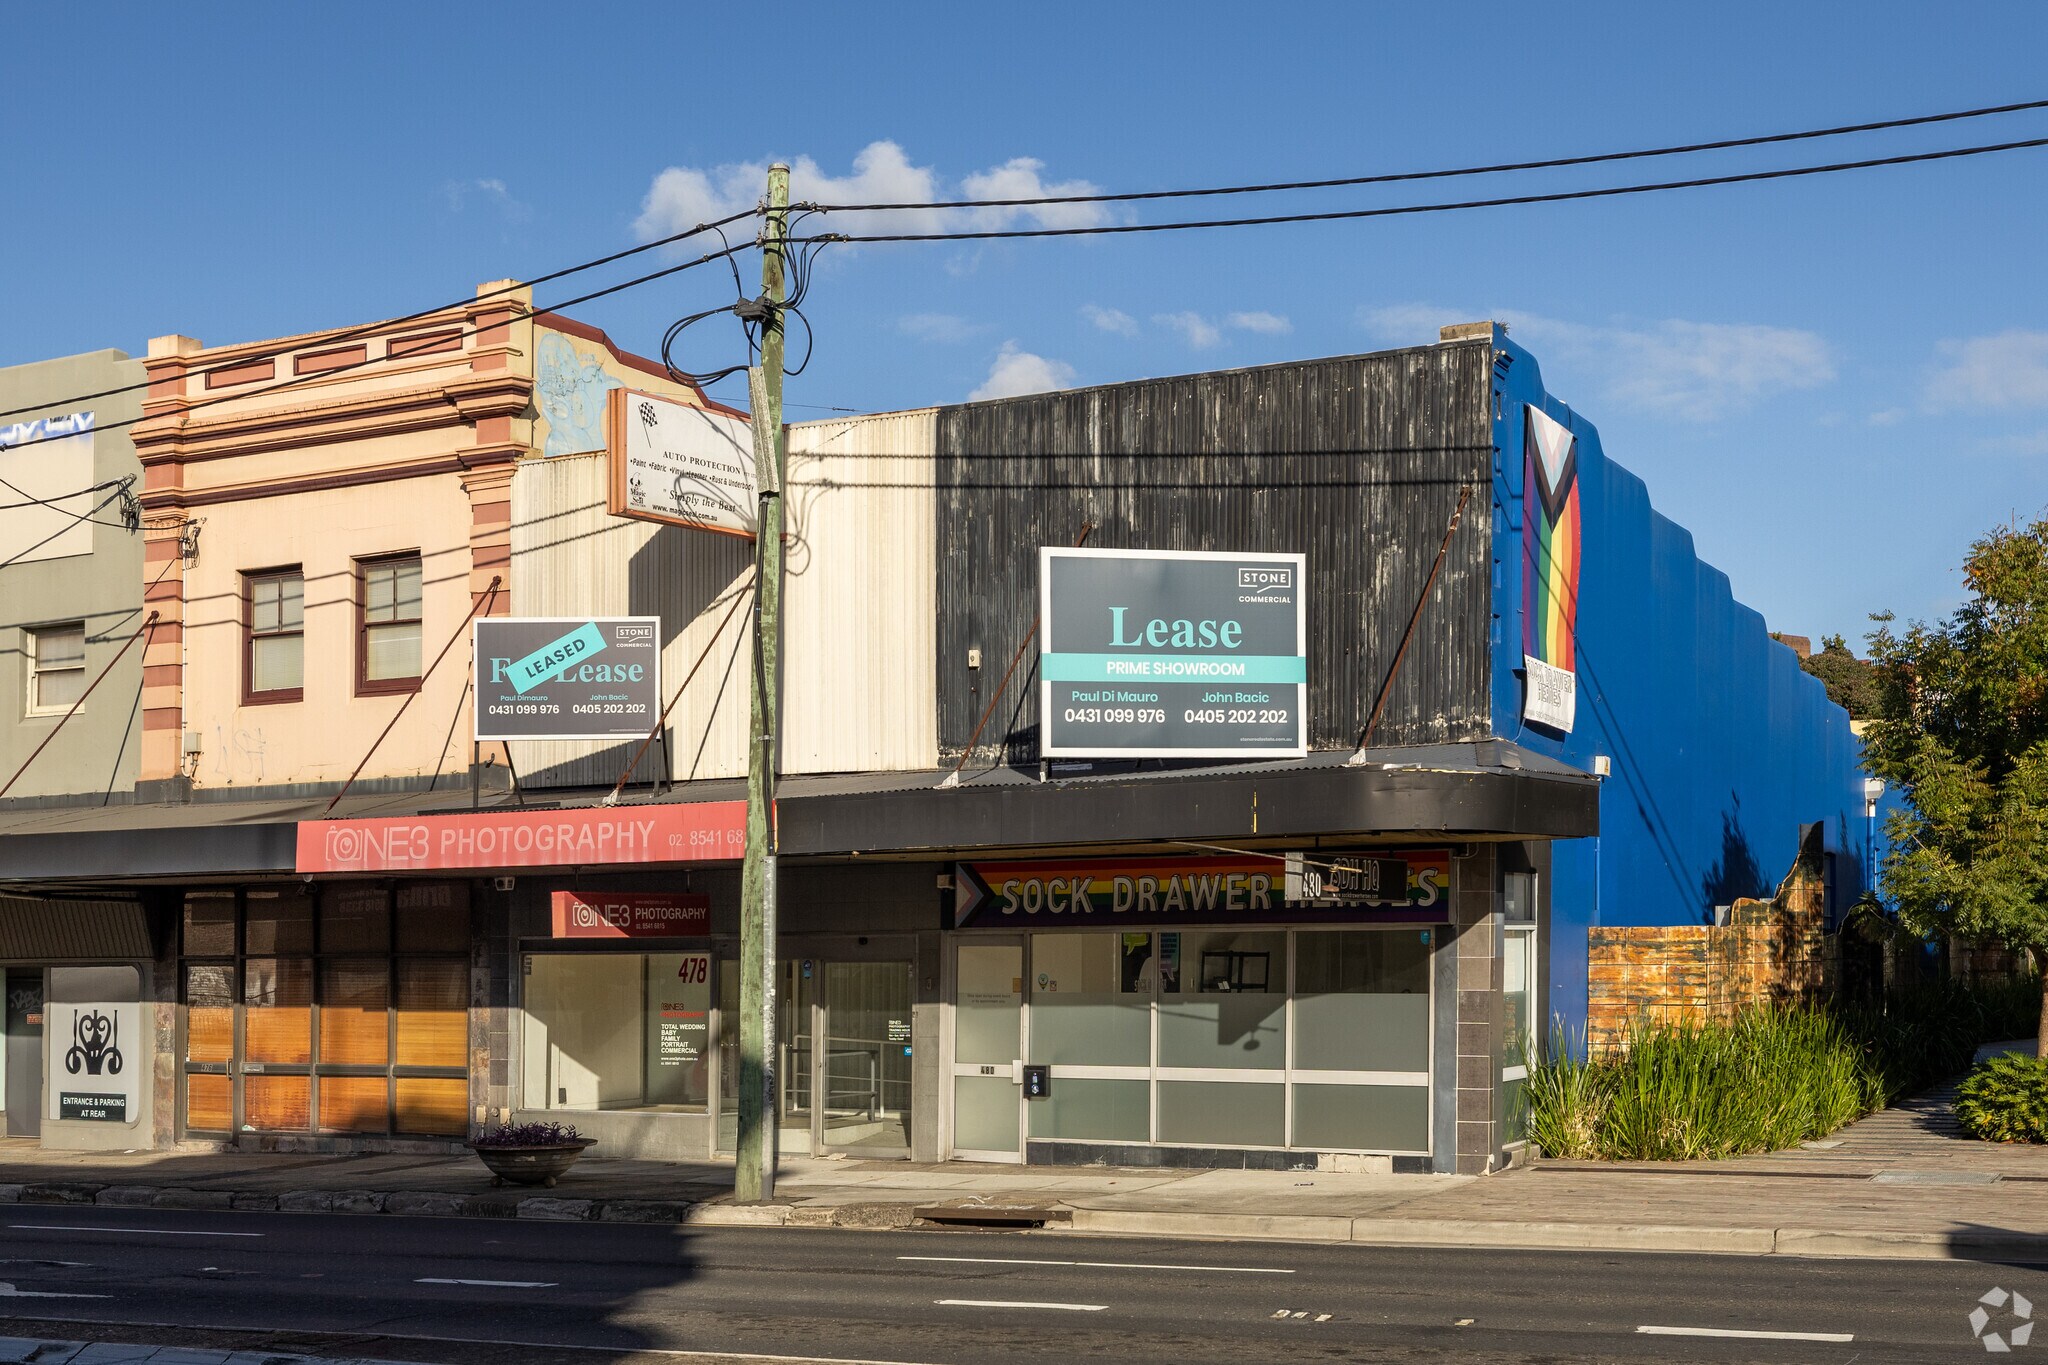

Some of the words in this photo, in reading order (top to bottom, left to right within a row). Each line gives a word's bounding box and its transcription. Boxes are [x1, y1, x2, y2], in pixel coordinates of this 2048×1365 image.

[662, 450, 687, 462] AUTO
[689, 455, 741, 475] PROTECTION
[712, 474, 723, 485] Rust
[728, 479, 755, 492] Underbody
[669, 489, 699, 507] Simply
[702, 496, 716, 508] the
[719, 500, 736, 513] Best
[1243, 572, 1287, 584] STONE
[1238, 595, 1291, 604] COMMERCIAL
[619, 628, 650, 637] STONE
[1108, 606, 1243, 649] Lease
[524, 638, 586, 679] LEASED
[1106, 661, 1151, 675] PRIME
[1153, 662, 1246, 676] SHOWROOM
[500, 694, 517, 702] Paul
[518, 694, 549, 702] Dimauro
[589, 693, 608, 702] John
[609, 693, 629, 701] Bacic
[1072, 690, 1100, 702] Paul
[1102, 690, 1115, 702] Di
[1117, 691, 1159, 702] Mauro
[1202, 692, 1233, 703] John
[1235, 692, 1270, 703] Bacic
[489, 704, 514, 715] 0431
[516, 704, 538, 715] 099
[539, 704, 560, 715] 976
[572, 704, 601, 715] 0405
[603, 704, 624, 714] 202
[625, 703, 647, 714] 202
[1064, 708, 1101, 723] 0431
[1104, 709, 1135, 723] 099
[1137, 709, 1166, 723] 976
[1184, 709, 1226, 724] 0405
[1228, 710, 1257, 724] 202
[1259, 710, 1288, 724] 202
[440, 820, 655, 855] PHOTOGRAPHY
[668, 834, 685, 847] 02.
[689, 829, 722, 846] 8541
[1362, 859, 1380, 892] HQ
[1302, 871, 1321, 898] 480
[1001, 876, 1096, 915] SOCK
[1112, 872, 1273, 912] DRAWER
[572, 901, 631, 928] ONE3
[635, 907, 707, 921] PHOTOGRAPHY
[678, 957, 708, 984] 478
[980, 1065, 995, 1075] 480
[63, 1096, 93, 1106] ENTRANCE
[94, 1098, 99, 1106] &
[99, 1098, 125, 1107] PARKING
[80, 1109, 90, 1118] AT
[89, 1109, 106, 1118] REAR
